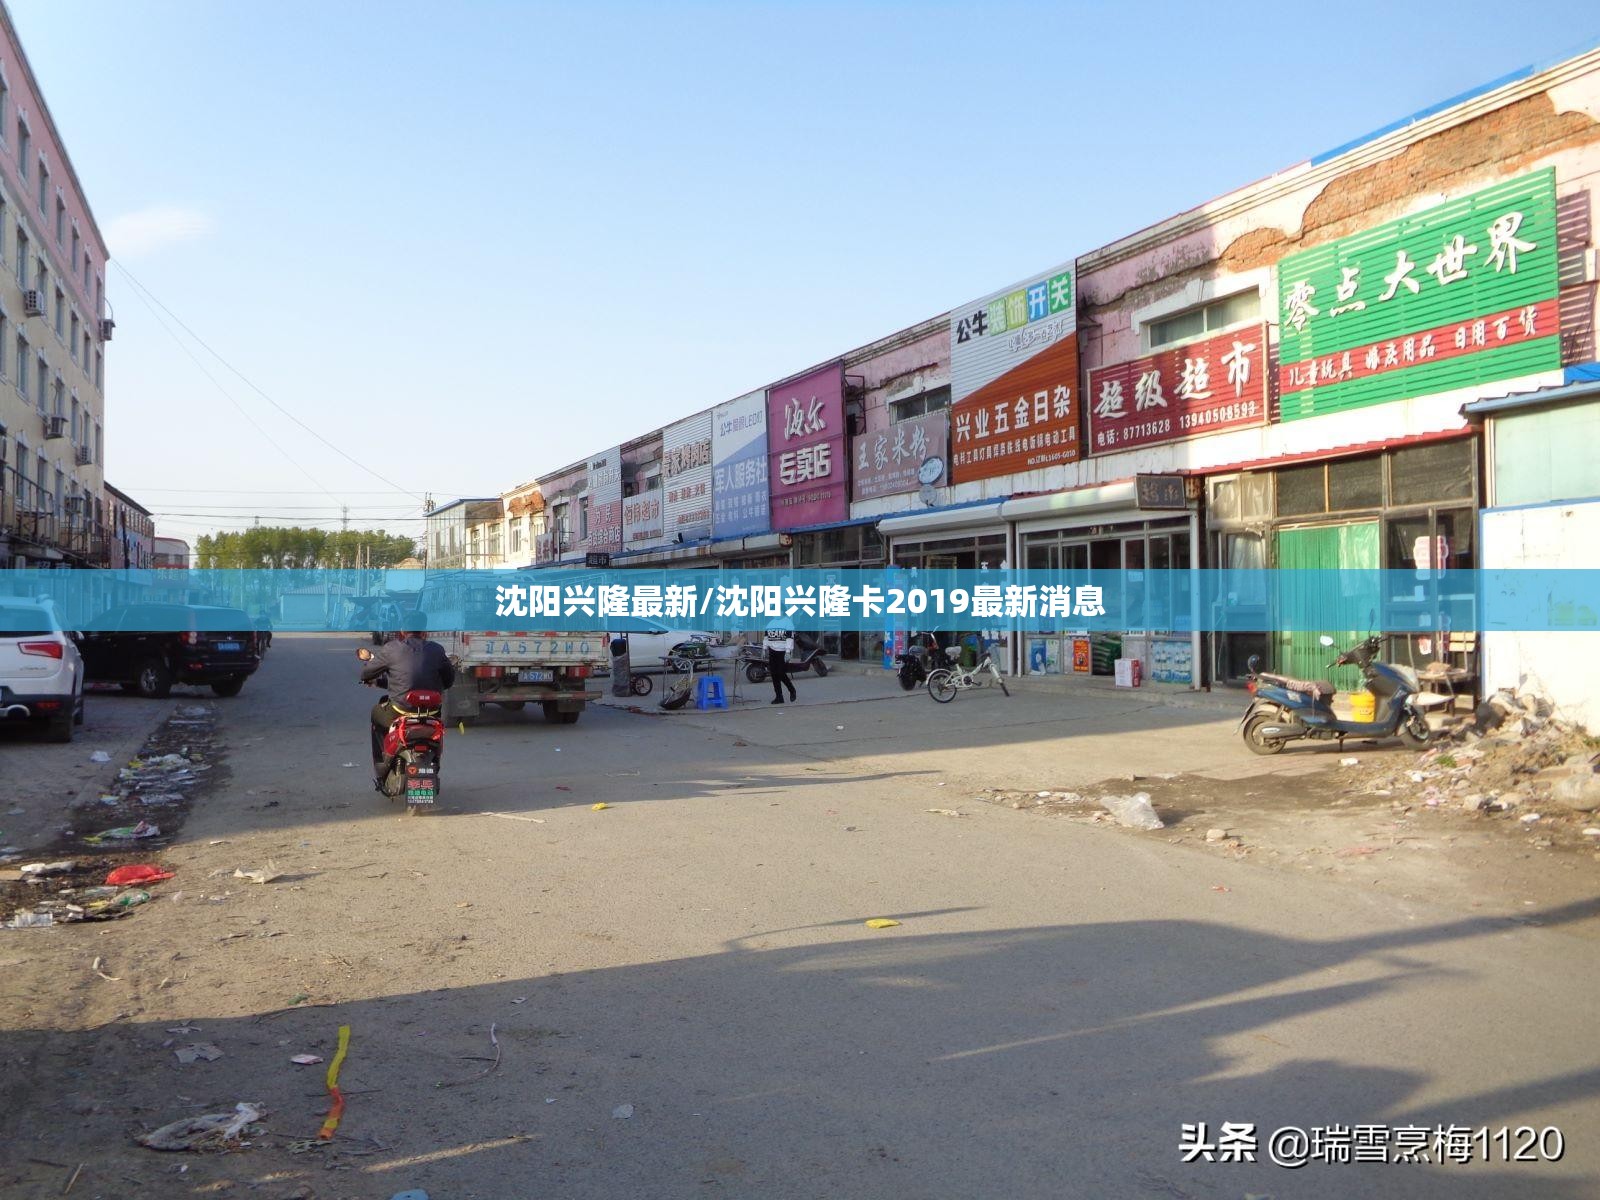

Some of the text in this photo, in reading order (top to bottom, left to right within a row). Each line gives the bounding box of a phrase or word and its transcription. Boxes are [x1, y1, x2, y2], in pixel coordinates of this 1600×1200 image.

[1284, 211, 1537, 331] 零点大世界
[1093, 341, 1256, 419] 超级超市
[1289, 351, 1353, 386] 儿童玩具
[1454, 305, 1538, 349] 日用百货
[956, 384, 1071, 443] 兴业五金日杂
[780, 443, 831, 485] 专卖店
